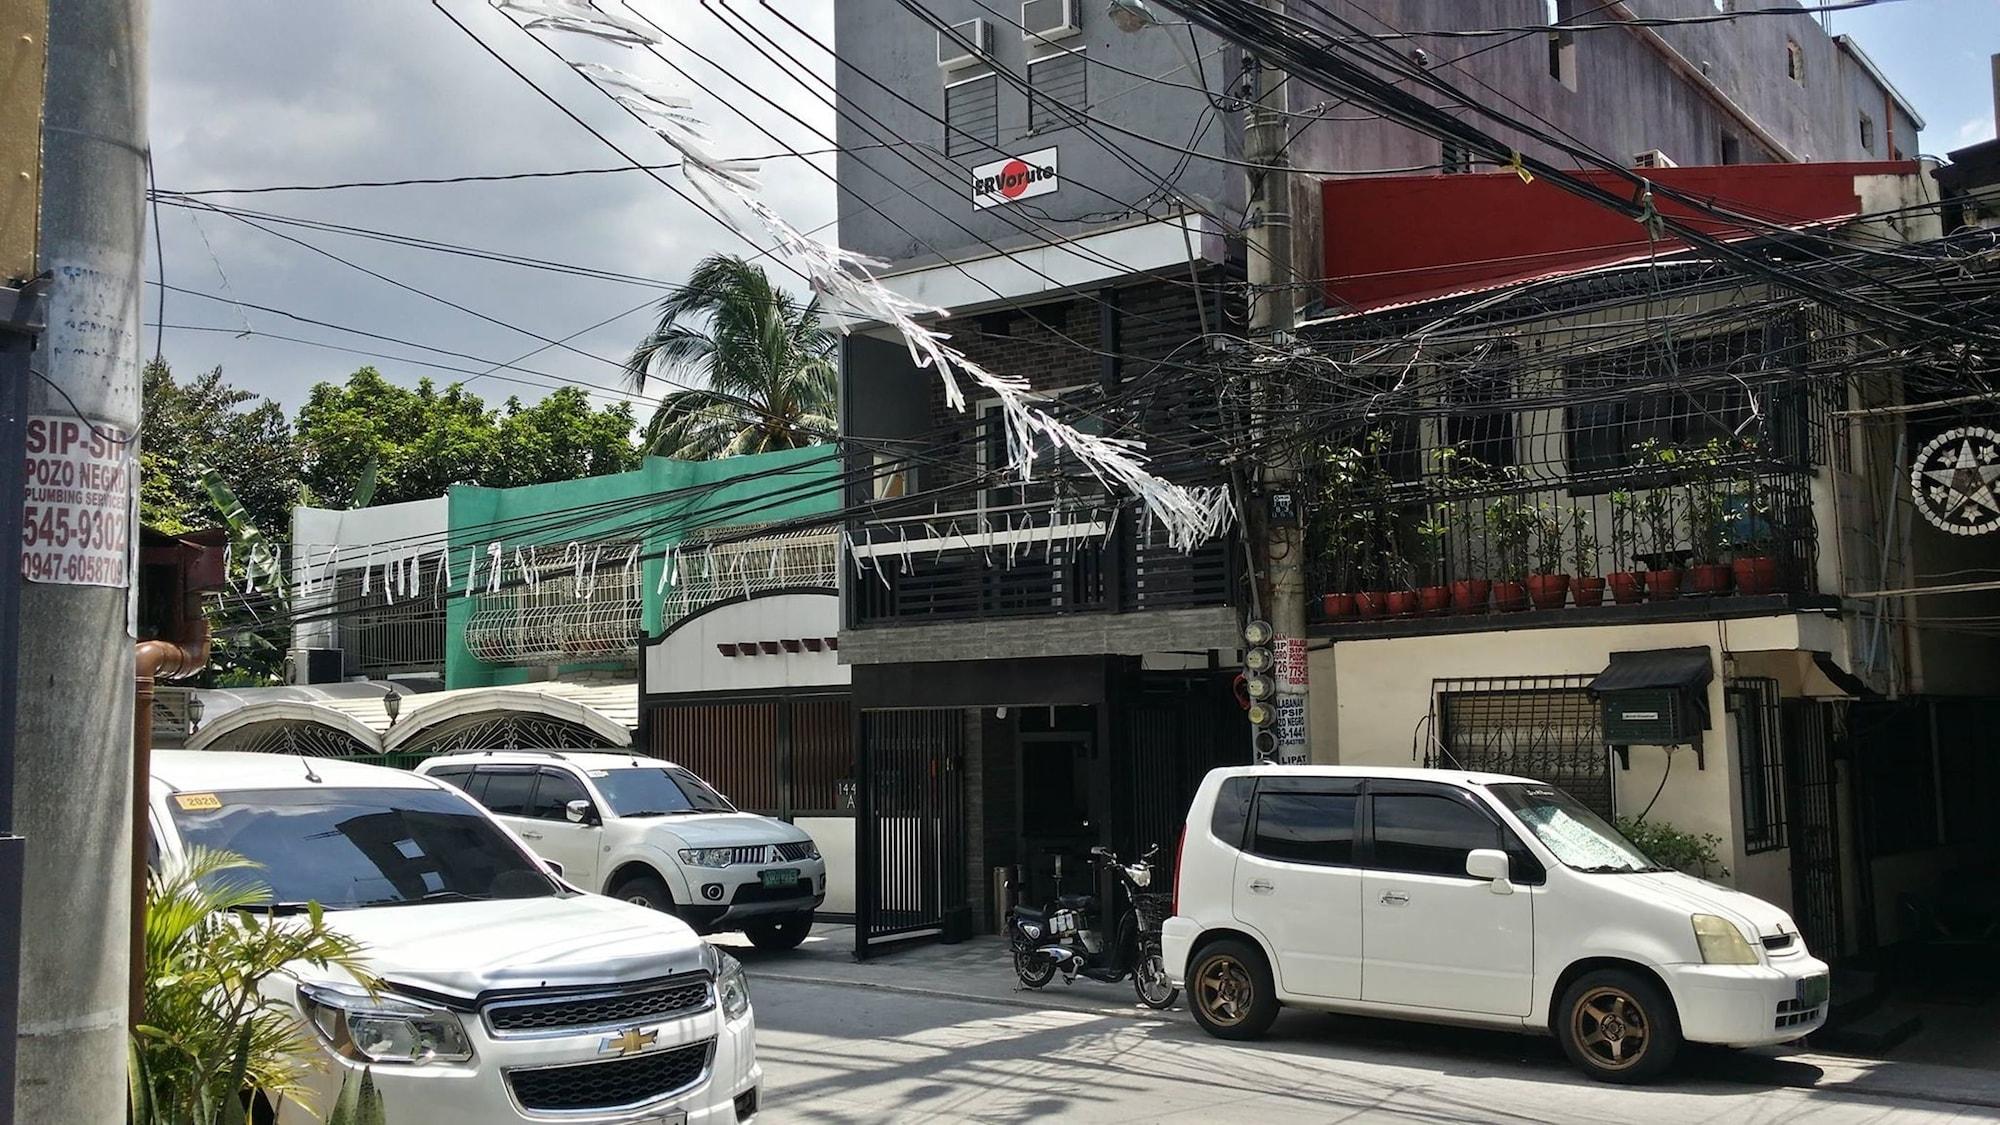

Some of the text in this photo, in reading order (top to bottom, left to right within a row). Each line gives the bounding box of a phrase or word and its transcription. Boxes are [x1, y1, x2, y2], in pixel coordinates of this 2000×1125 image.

[25, 419, 128, 461] SIP-SIP
[25, 458, 126, 493] POZO NEGRO
[24, 487, 126, 510] PLUMBING SERVICES
[23, 506, 125, 552] 545-9302
[22, 552, 124, 585] 0947-6058709
[1281, 755, 1306, 764] LIPAT
[846, 794, 856, 809] A
